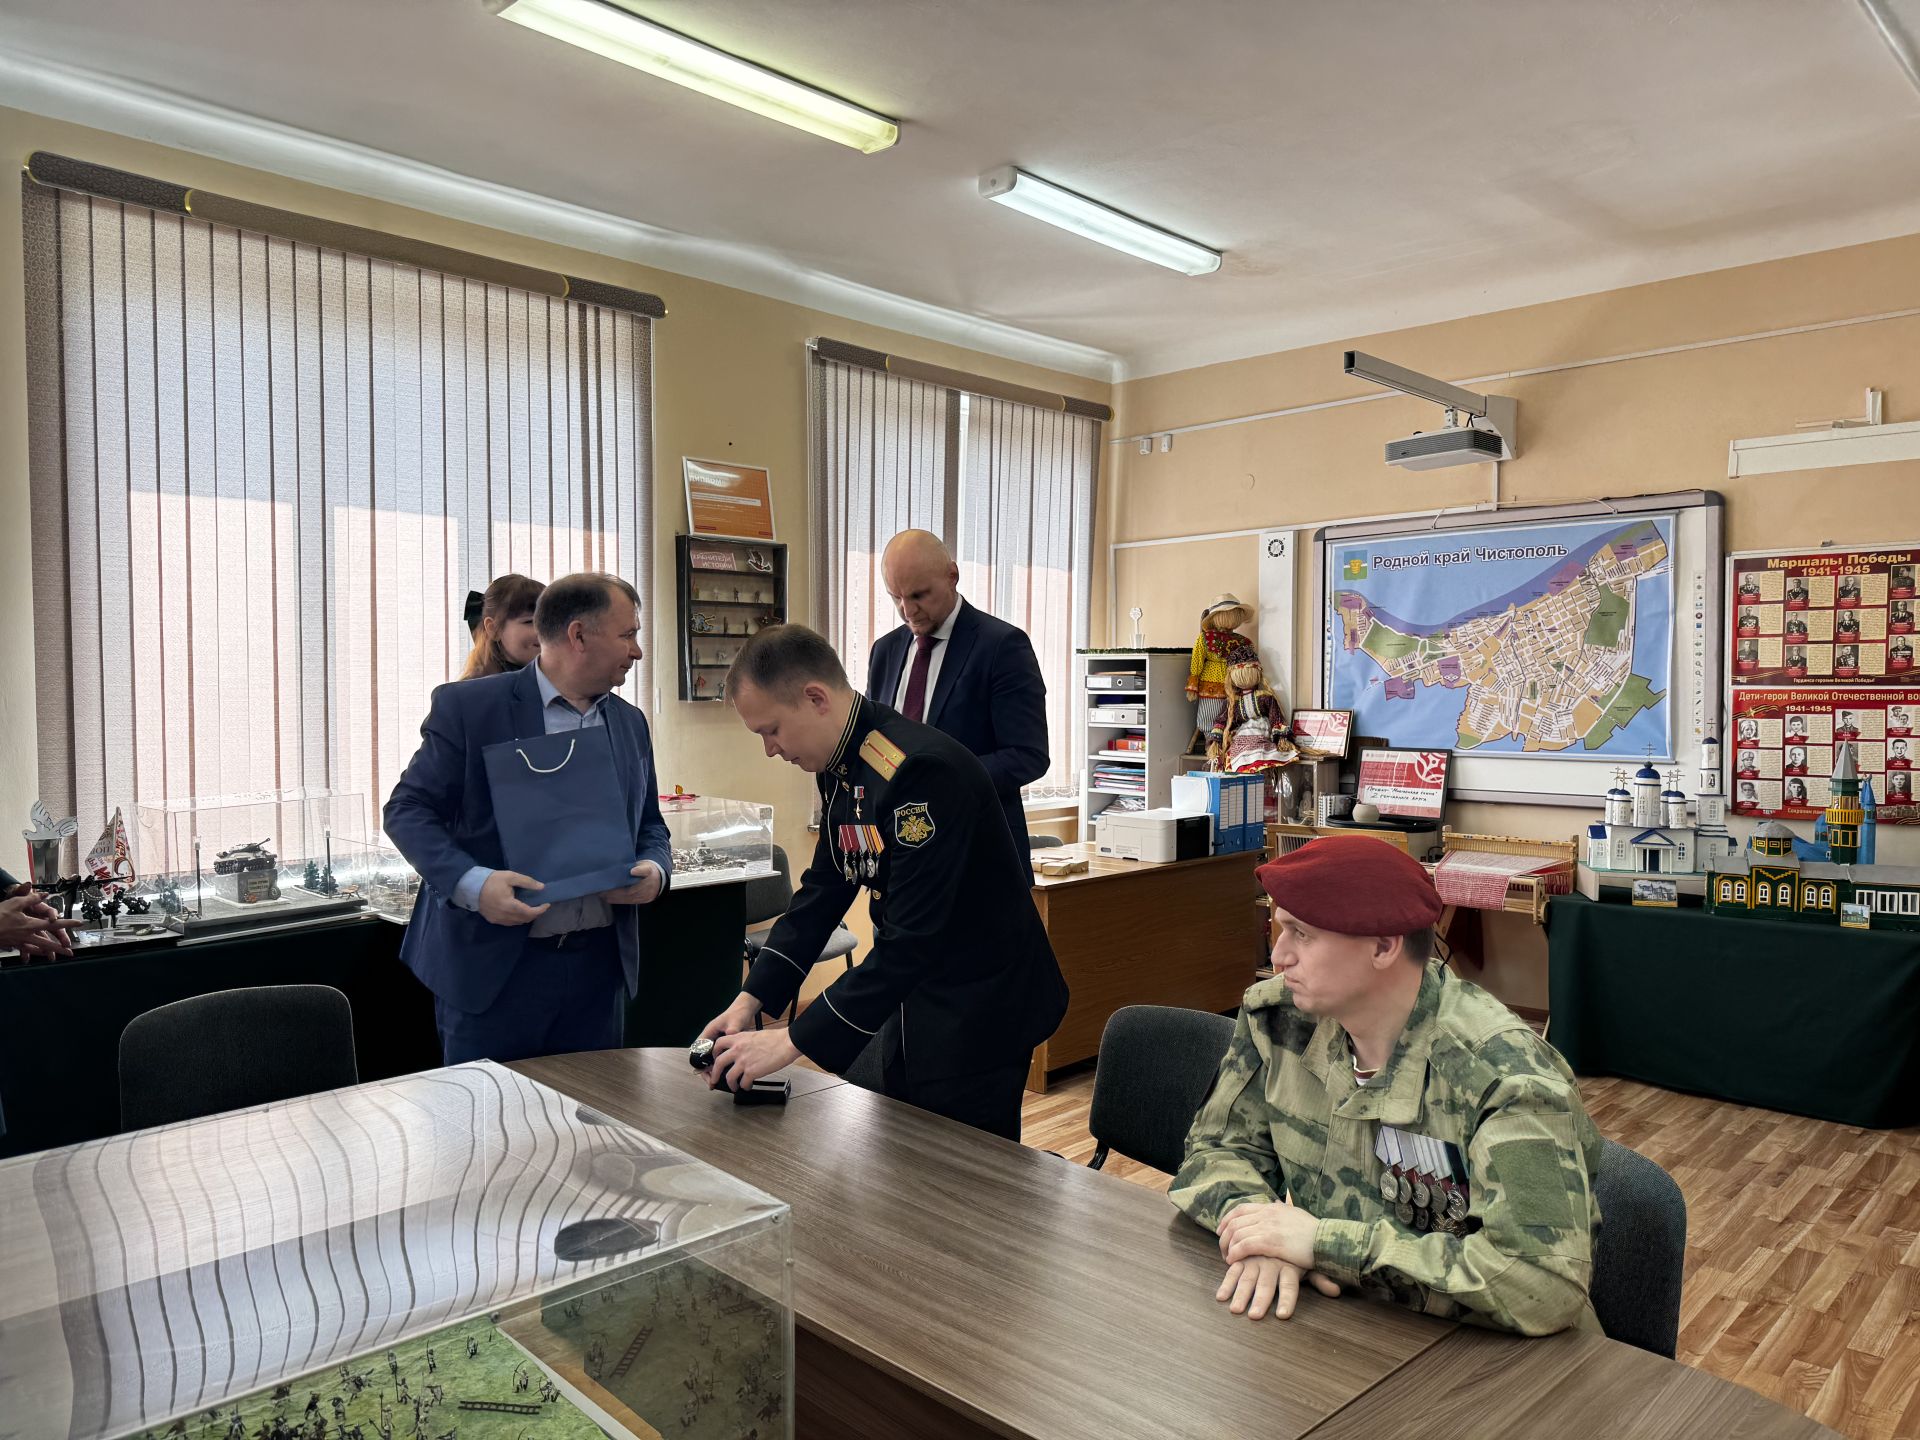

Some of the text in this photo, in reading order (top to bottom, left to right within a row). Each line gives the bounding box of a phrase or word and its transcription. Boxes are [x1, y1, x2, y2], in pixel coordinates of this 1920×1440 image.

[1373, 544, 1568, 570] Родной край Чистополь
[1767, 553, 1912, 570] Маршалы Победы
[1801, 565, 1871, 576] 1941-1945
[1739, 691, 1920, 701] Дети-герои Великой Отечественной во
[896, 806, 925, 817] РОССИЯ
